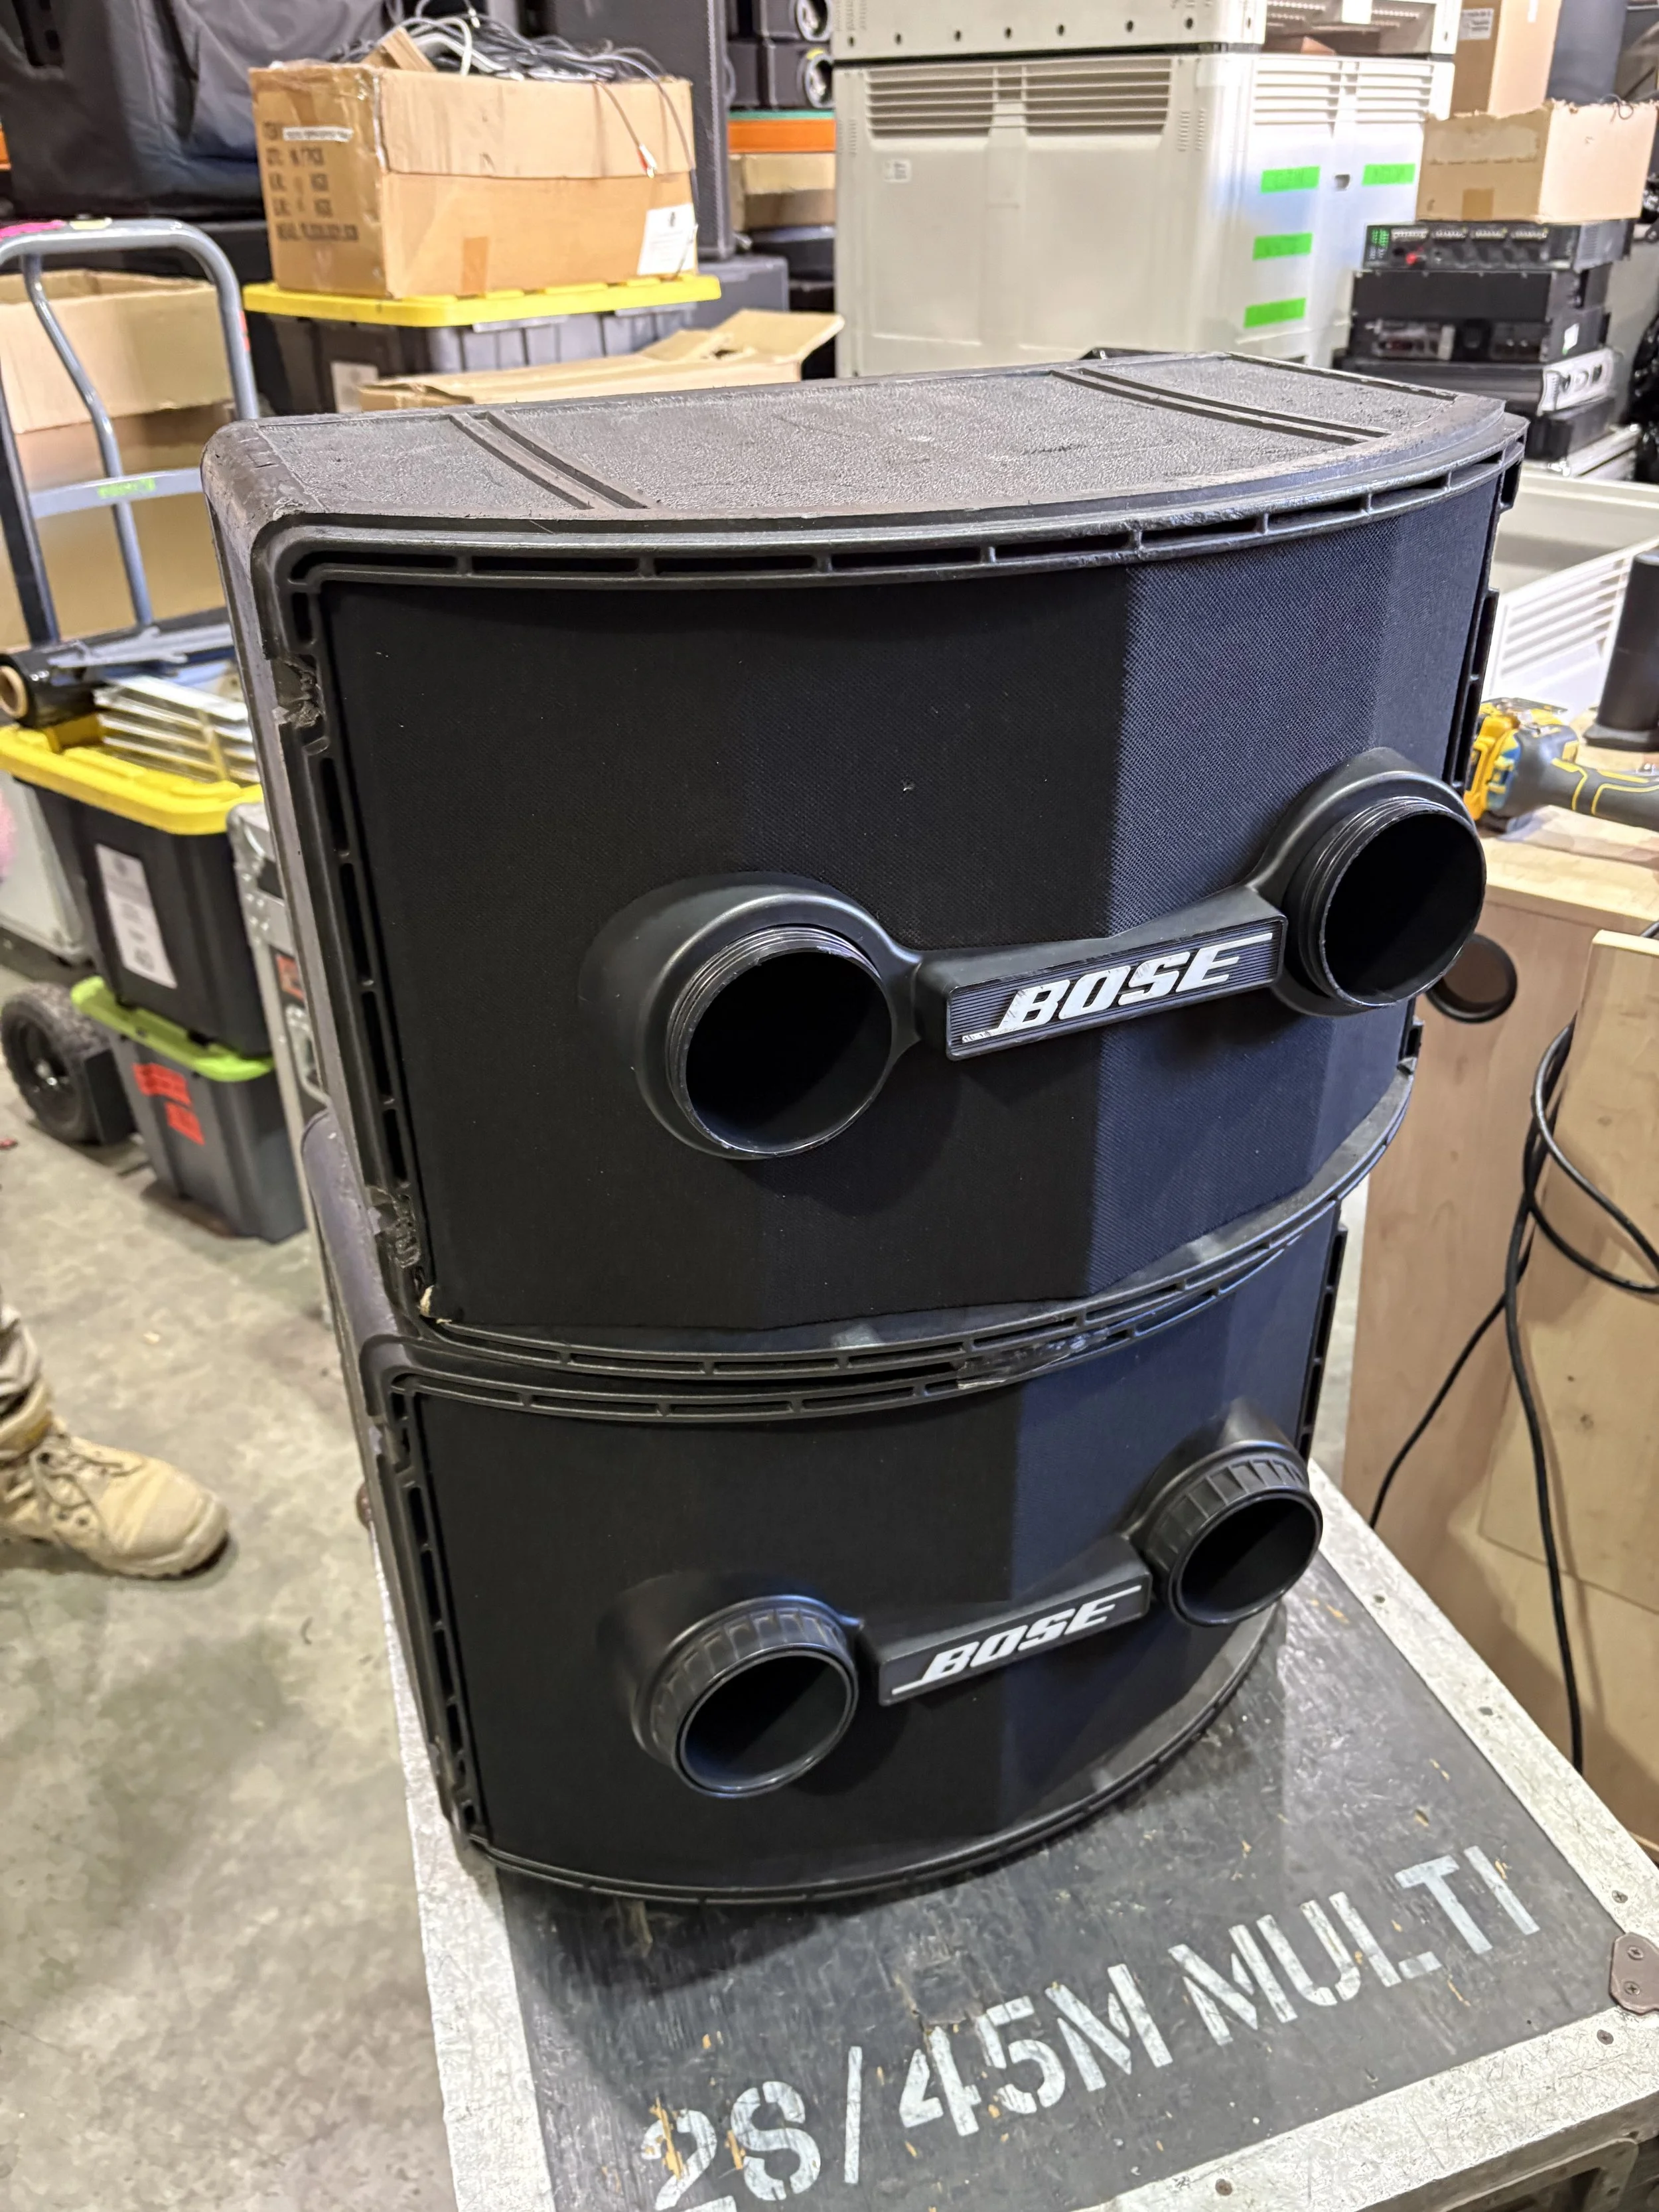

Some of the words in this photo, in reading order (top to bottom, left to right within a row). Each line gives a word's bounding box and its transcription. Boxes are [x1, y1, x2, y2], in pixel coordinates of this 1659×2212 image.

[962, 932, 1273, 1043] BOSE
[891, 1585, 1142, 1695] BOSE
[1168, 1845, 1540, 2046] MULTI
